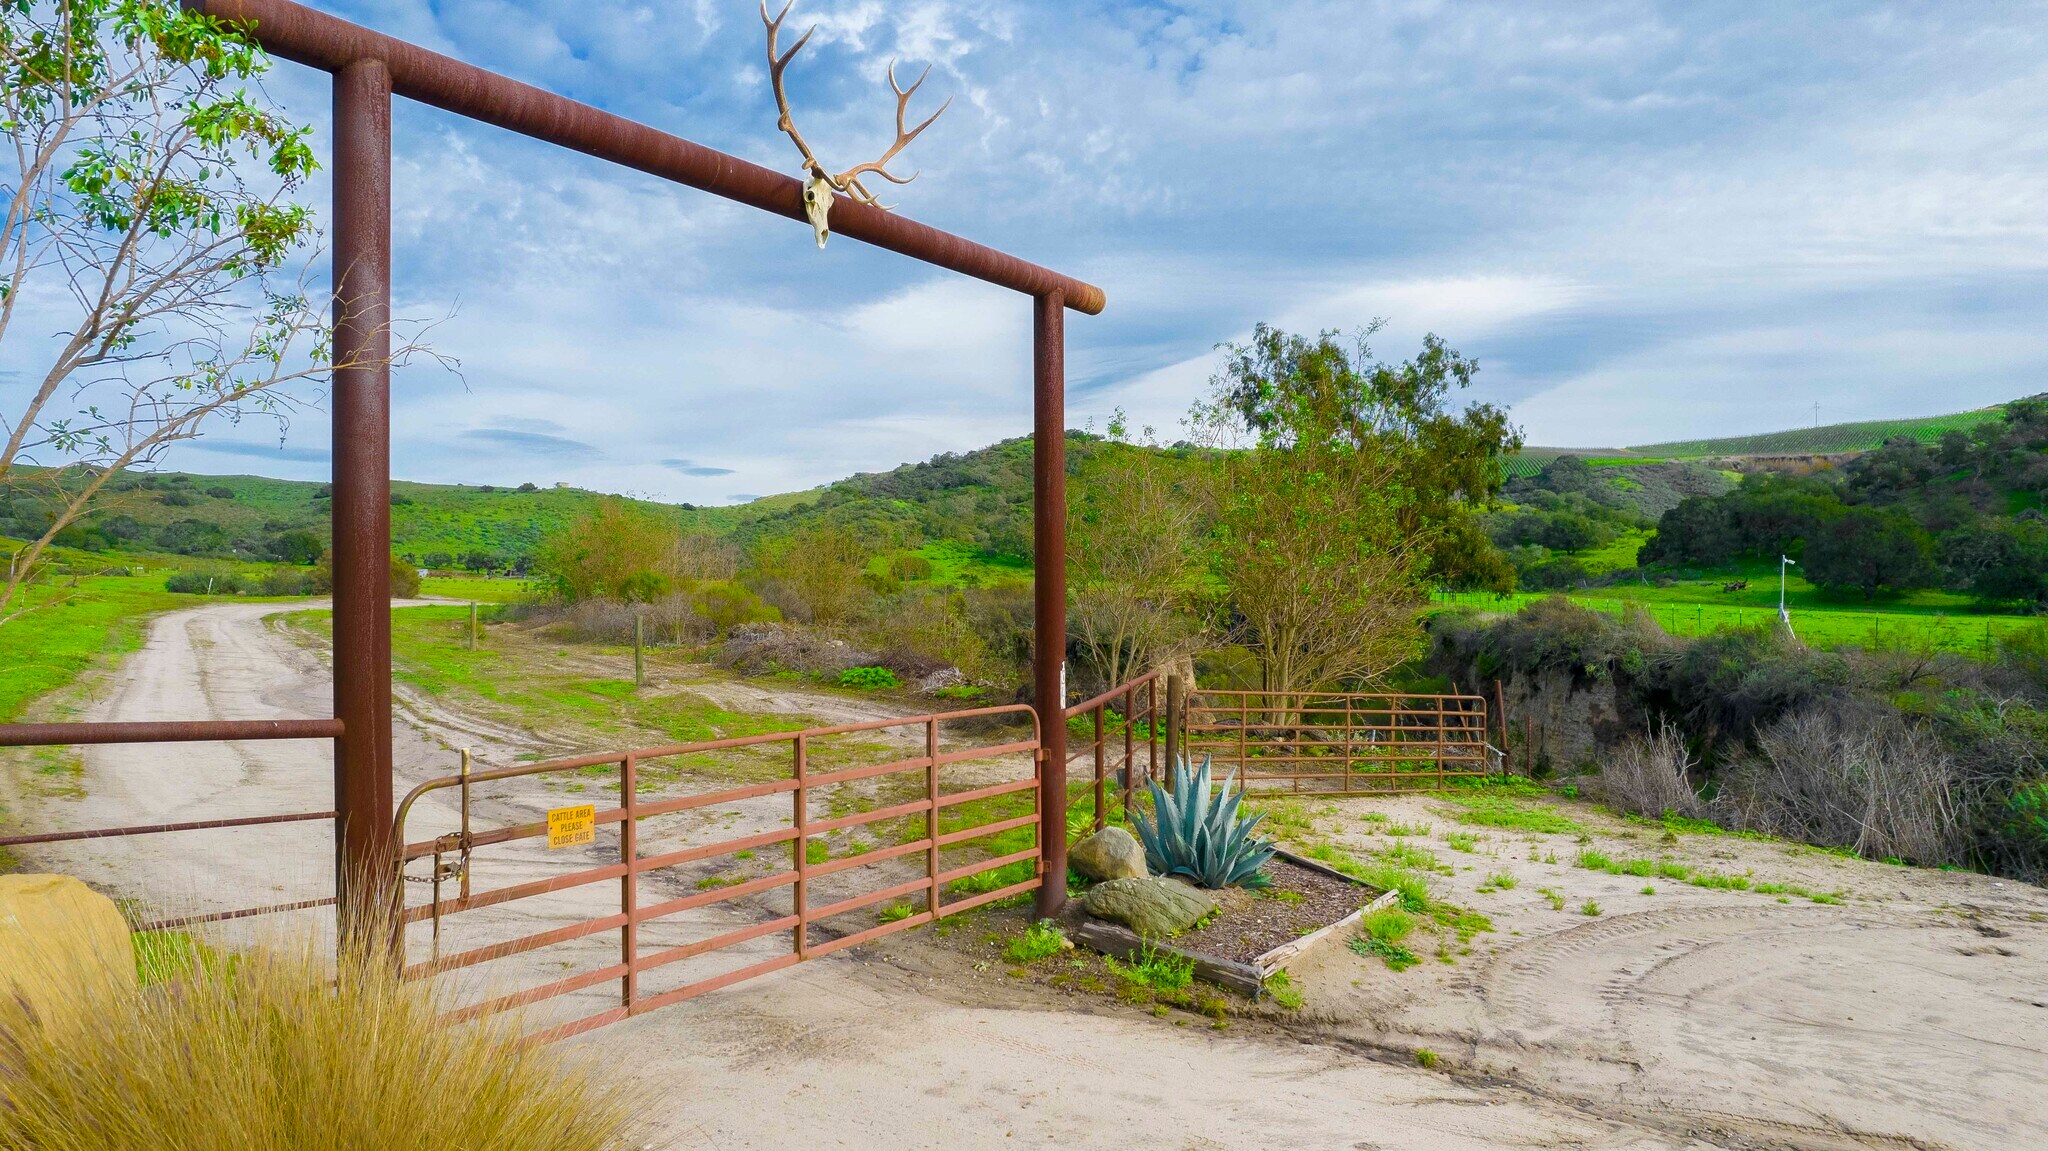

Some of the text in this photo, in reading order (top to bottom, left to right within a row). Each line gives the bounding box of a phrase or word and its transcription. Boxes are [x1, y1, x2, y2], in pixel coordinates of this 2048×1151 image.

[551, 808, 591, 822] CATTLE AREA
[560, 821, 583, 832] PLEASE
[553, 831, 590, 845] CLOSE GATE
